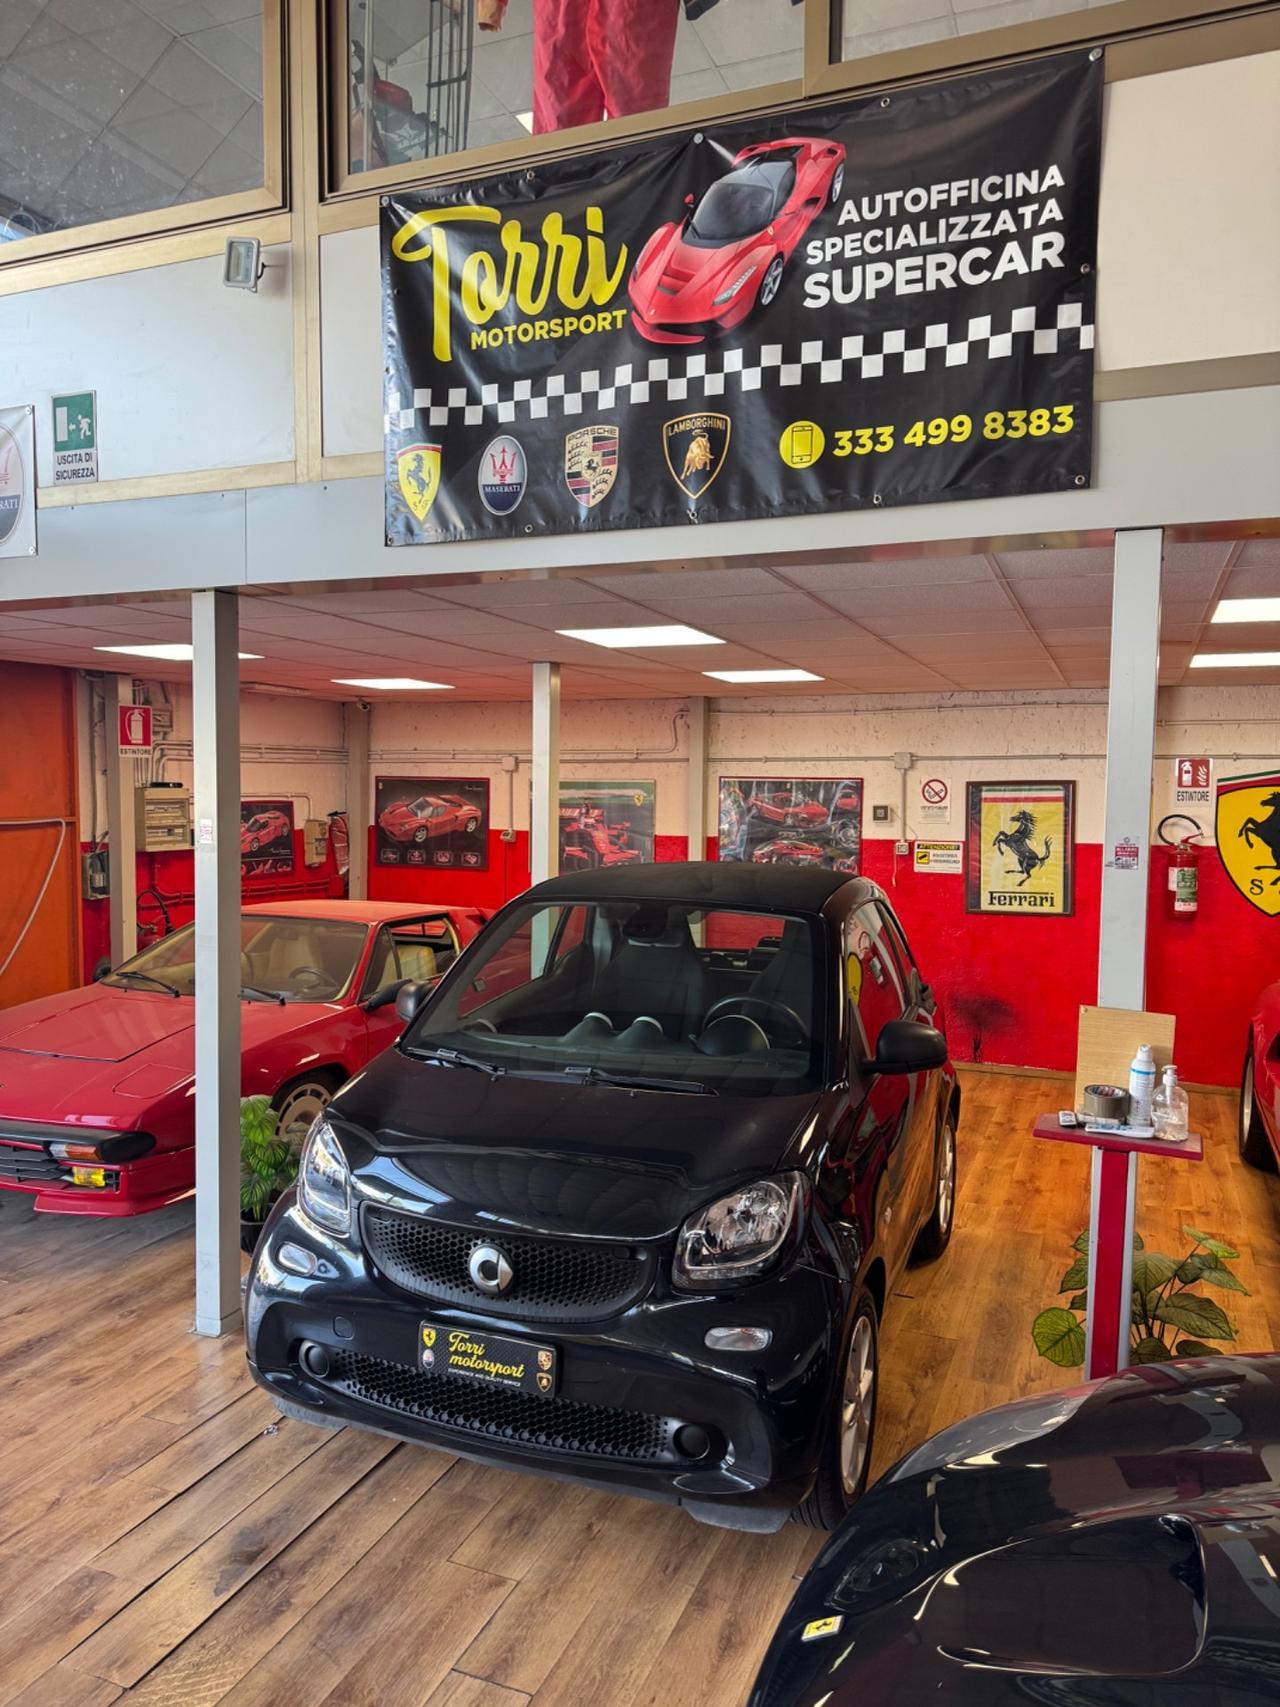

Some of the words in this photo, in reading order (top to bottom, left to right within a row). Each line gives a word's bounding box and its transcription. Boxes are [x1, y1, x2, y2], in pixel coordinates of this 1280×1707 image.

[837, 164, 1065, 226] AUTOFFICINA
[805, 198, 1064, 265] SPECIALIZZATA
[803, 231, 1066, 308] SUPERCAR
[391, 205, 628, 362] Torri
[471, 308, 627, 350] MOTORSPORT
[567, 427, 617, 442] PORSCHE
[668, 417, 726, 436] LAMBORGHINI
[832, 425, 894, 457] 333
[903, 414, 972, 447] 499
[982, 405, 1074, 440] 8383
[56, 453, 83, 466] USCITA
[84, 452, 93, 463] DI
[55, 466, 96, 481] SICUREZZA
[484, 484, 521, 493] MASERATI
[120, 747, 152, 756] ESTINTORE
[1176, 791, 1210, 802] ESTINTORE
[987, 890, 1056, 908] Ferrari
[449, 1331, 485, 1355] Torri
[449, 1355, 525, 1378] motorsport
